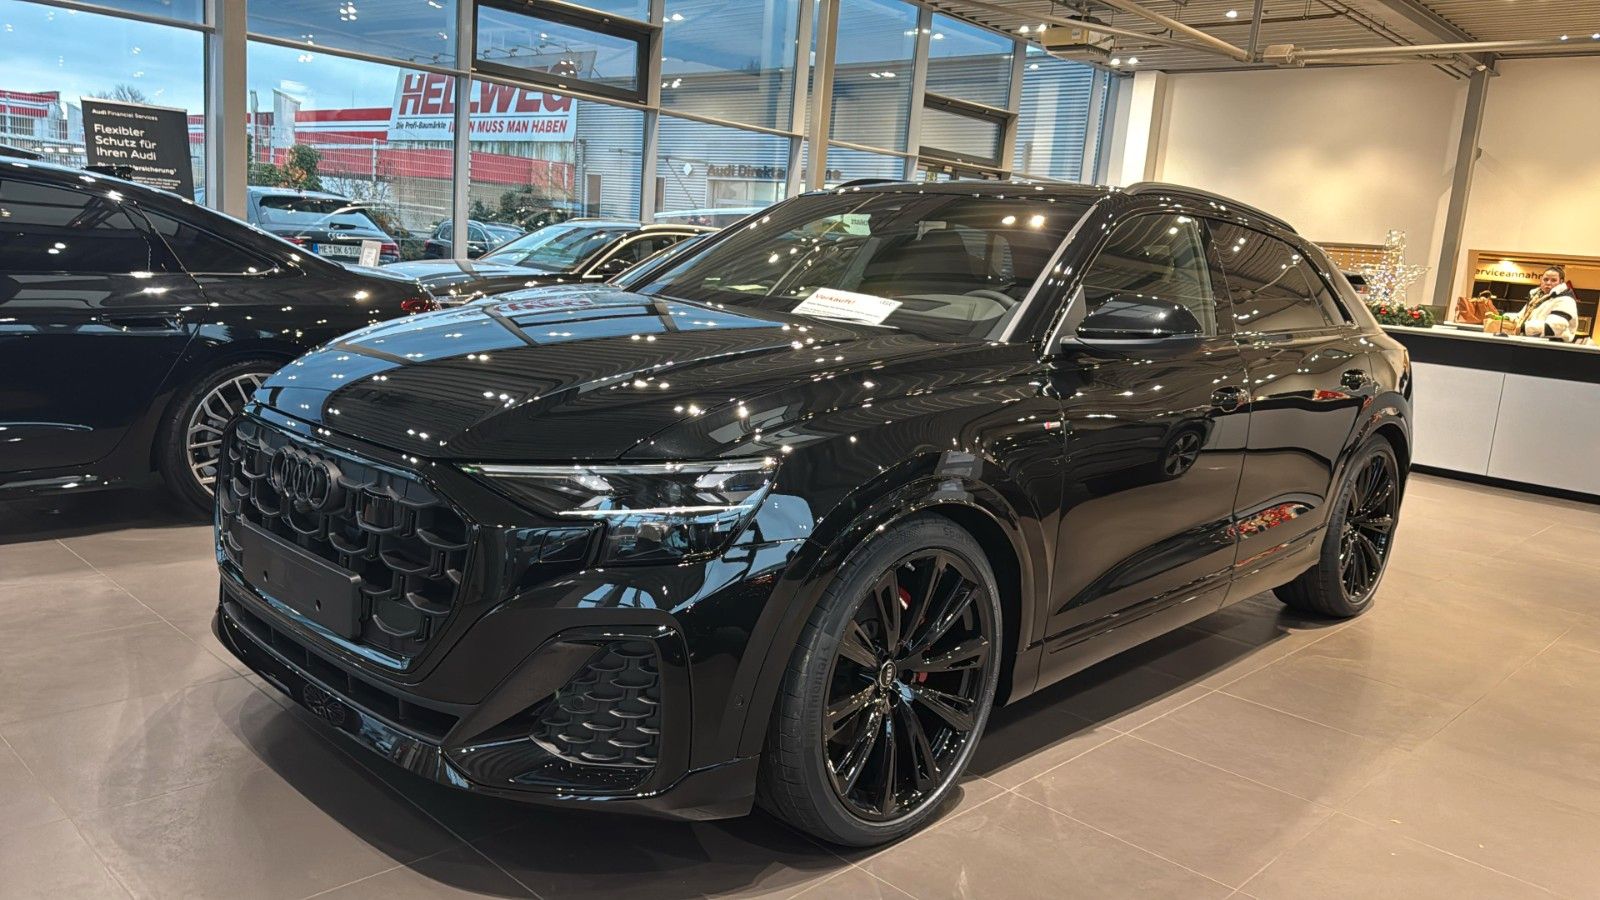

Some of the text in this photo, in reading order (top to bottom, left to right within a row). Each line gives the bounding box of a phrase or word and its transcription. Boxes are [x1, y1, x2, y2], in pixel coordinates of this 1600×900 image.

[107, 110, 134, 118] Financial
[135, 113, 158, 121] Services
[93, 123, 145, 137] Flexibler
[477, 120, 504, 133] MUSS
[507, 120, 529, 133] MAN
[531, 120, 567, 133] HABEN
[95, 135, 157, 149] Schutz für
[96, 147, 157, 161] Ihren Audi
[707, 165, 735, 177] Audi
